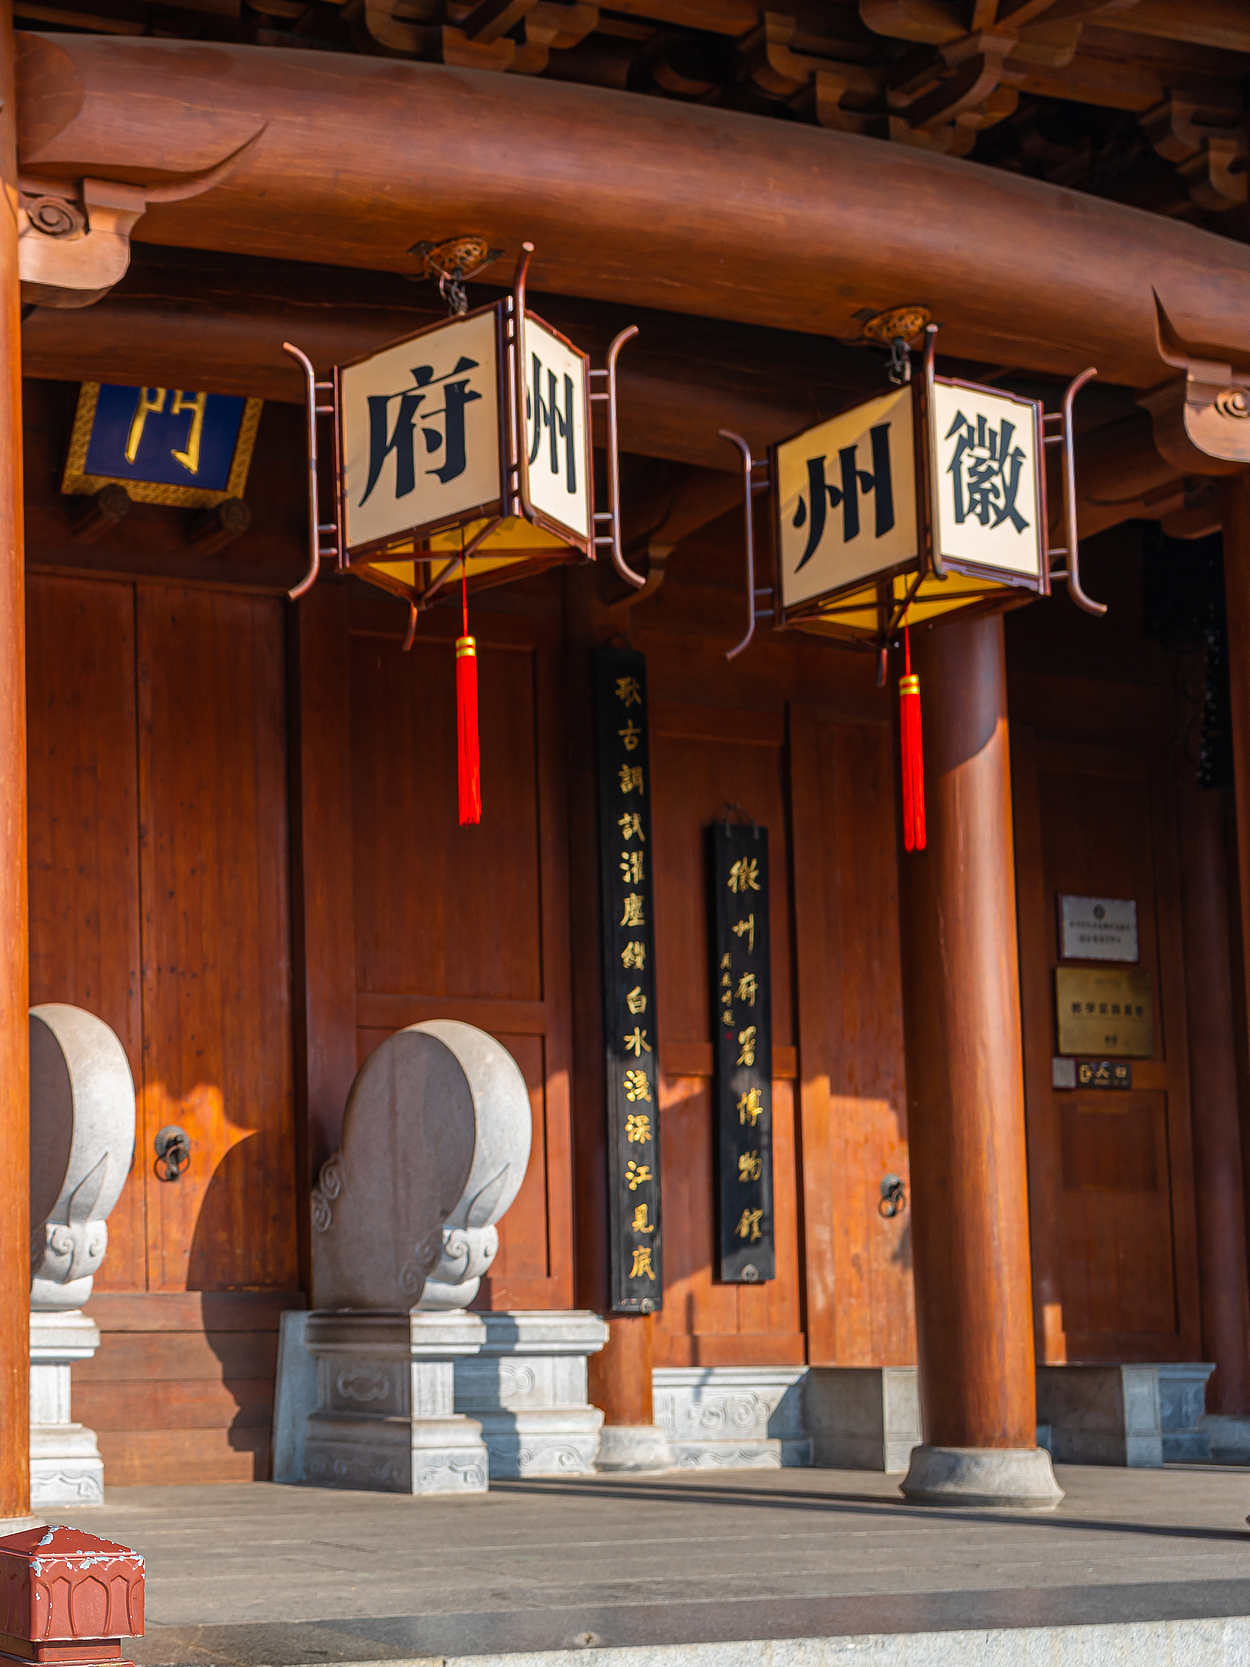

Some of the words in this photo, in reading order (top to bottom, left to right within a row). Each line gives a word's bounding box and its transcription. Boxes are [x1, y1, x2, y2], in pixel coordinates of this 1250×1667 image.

[124, 386, 208, 475] 門
[357, 355, 484, 508] 府
[525, 350, 577, 495] 州
[943, 408, 1031, 535] 徽
[792, 421, 895, 574] 州
